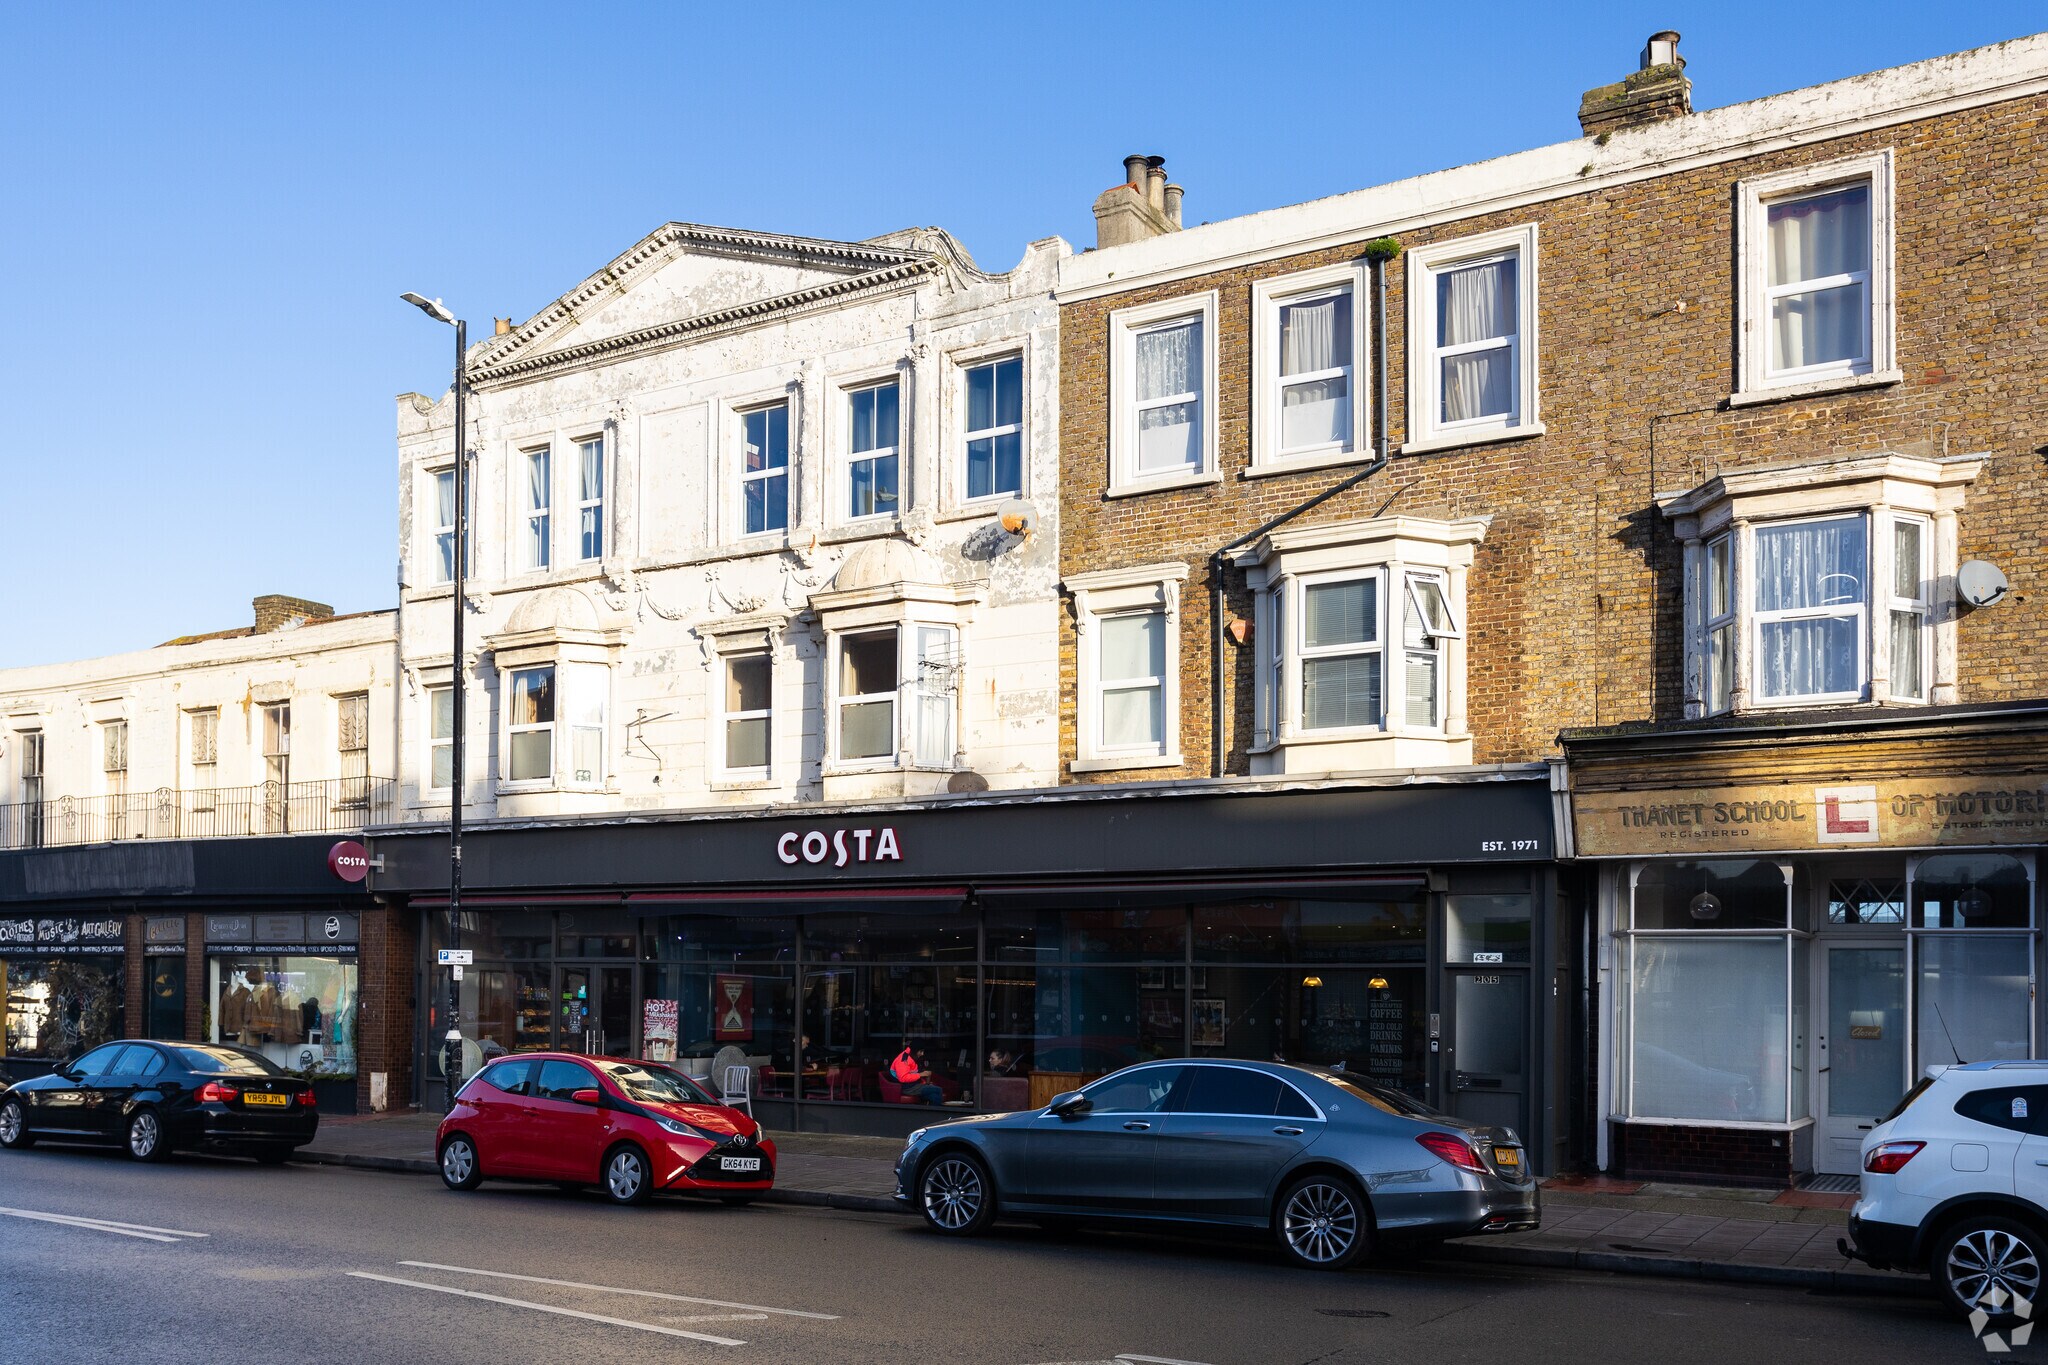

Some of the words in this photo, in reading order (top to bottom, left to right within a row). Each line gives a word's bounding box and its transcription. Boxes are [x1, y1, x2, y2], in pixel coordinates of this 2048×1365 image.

[1892, 794, 1925, 817] OF
[1618, 803, 1706, 827] THANET
[1714, 800, 1806, 824] SCHOOL
[1825, 795, 1869, 833] L
[1931, 819, 2034, 830] ESTABLISHED
[1660, 829, 1750, 839] REGISTERED
[777, 827, 903, 867] COSTA
[1482, 841, 1507, 851] EST.
[1511, 840, 1538, 850] 1971
[337, 856, 366, 867] COSTA
[0, 919, 34, 941] CLOTHES
[38, 923, 64, 941] MUSIC
[647, 1003, 665, 1011] HOT
[1370, 1008, 1402, 1019] COFFEE
[1370, 1022, 1385, 1030] ICED
[1370, 1031, 1402, 1040] DRINKS
[1370, 1043, 1402, 1054] PANINIS
[1370, 1058, 1402, 1067] TOASTED
[247, 1094, 268, 1103] YR59
[269, 1095, 283, 1104] JYL
[723, 1158, 743, 1169] GK64
[743, 1159, 758, 1169] KYE
